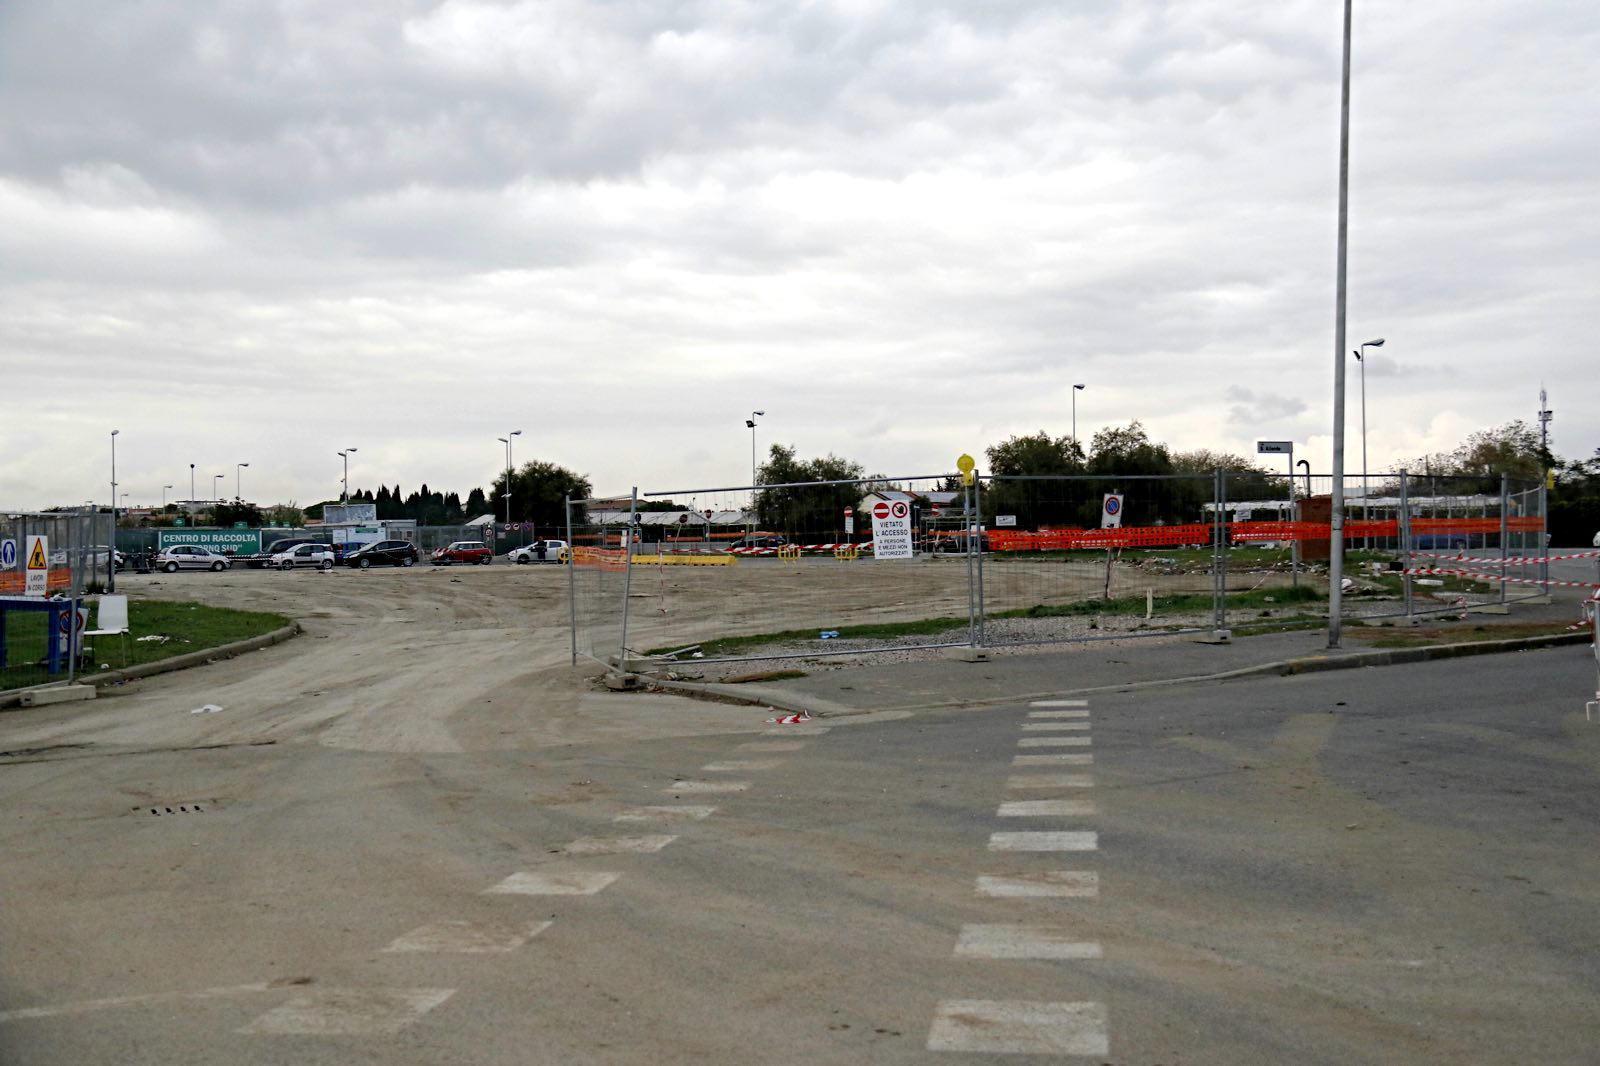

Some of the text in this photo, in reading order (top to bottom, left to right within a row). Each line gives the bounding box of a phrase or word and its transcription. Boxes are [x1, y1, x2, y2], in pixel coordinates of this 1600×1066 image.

[163, 534, 257, 543] CENTRO DI RACCOLTA
